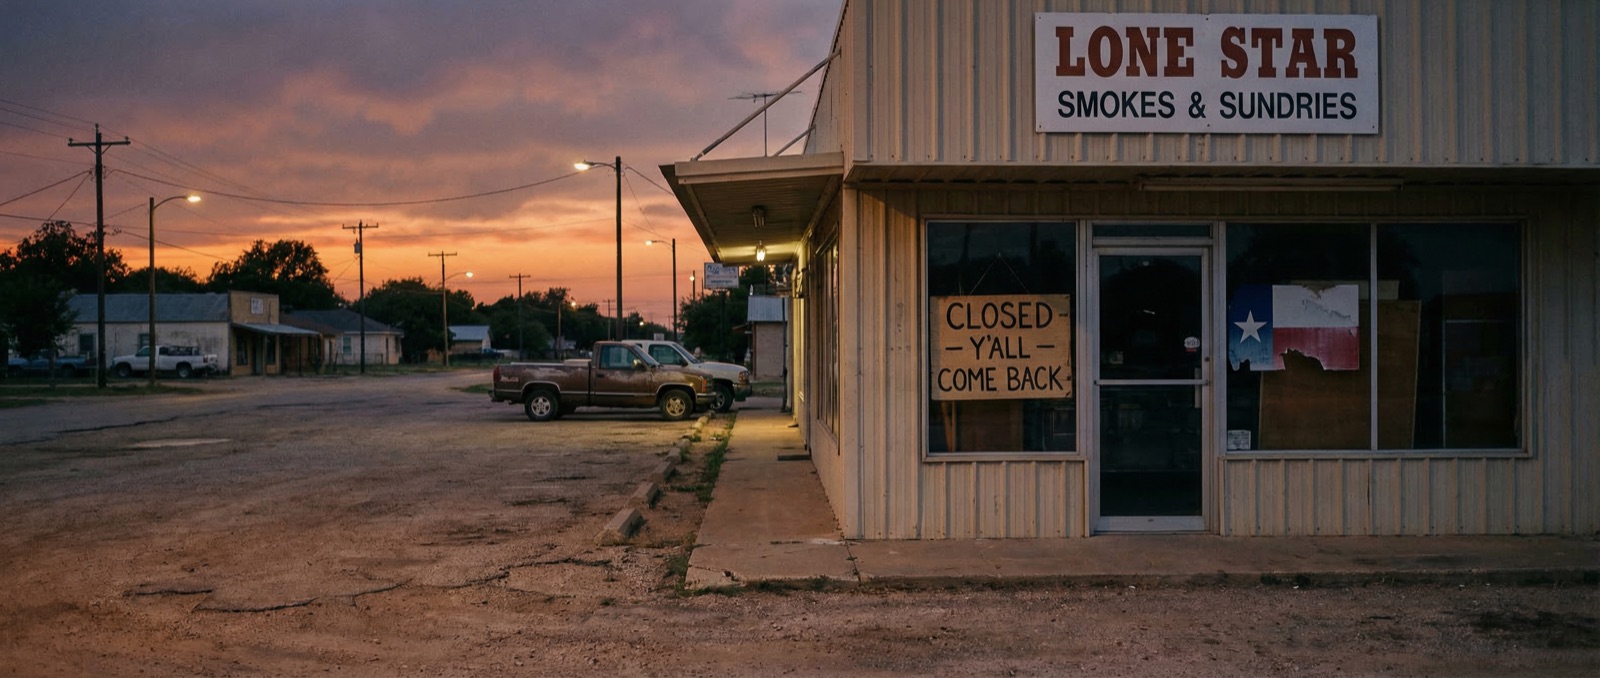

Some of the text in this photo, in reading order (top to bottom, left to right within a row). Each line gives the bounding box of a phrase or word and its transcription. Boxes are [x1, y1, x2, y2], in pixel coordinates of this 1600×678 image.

[1055, 25, 1358, 79] LONE STAR
[1057, 90, 1357, 120] SMOKES & SUNDRIES
[946, 302, 1053, 330] CLOSED
[969, 334, 1031, 360] Y'ALL
[937, 365, 1064, 392] COME BACK
